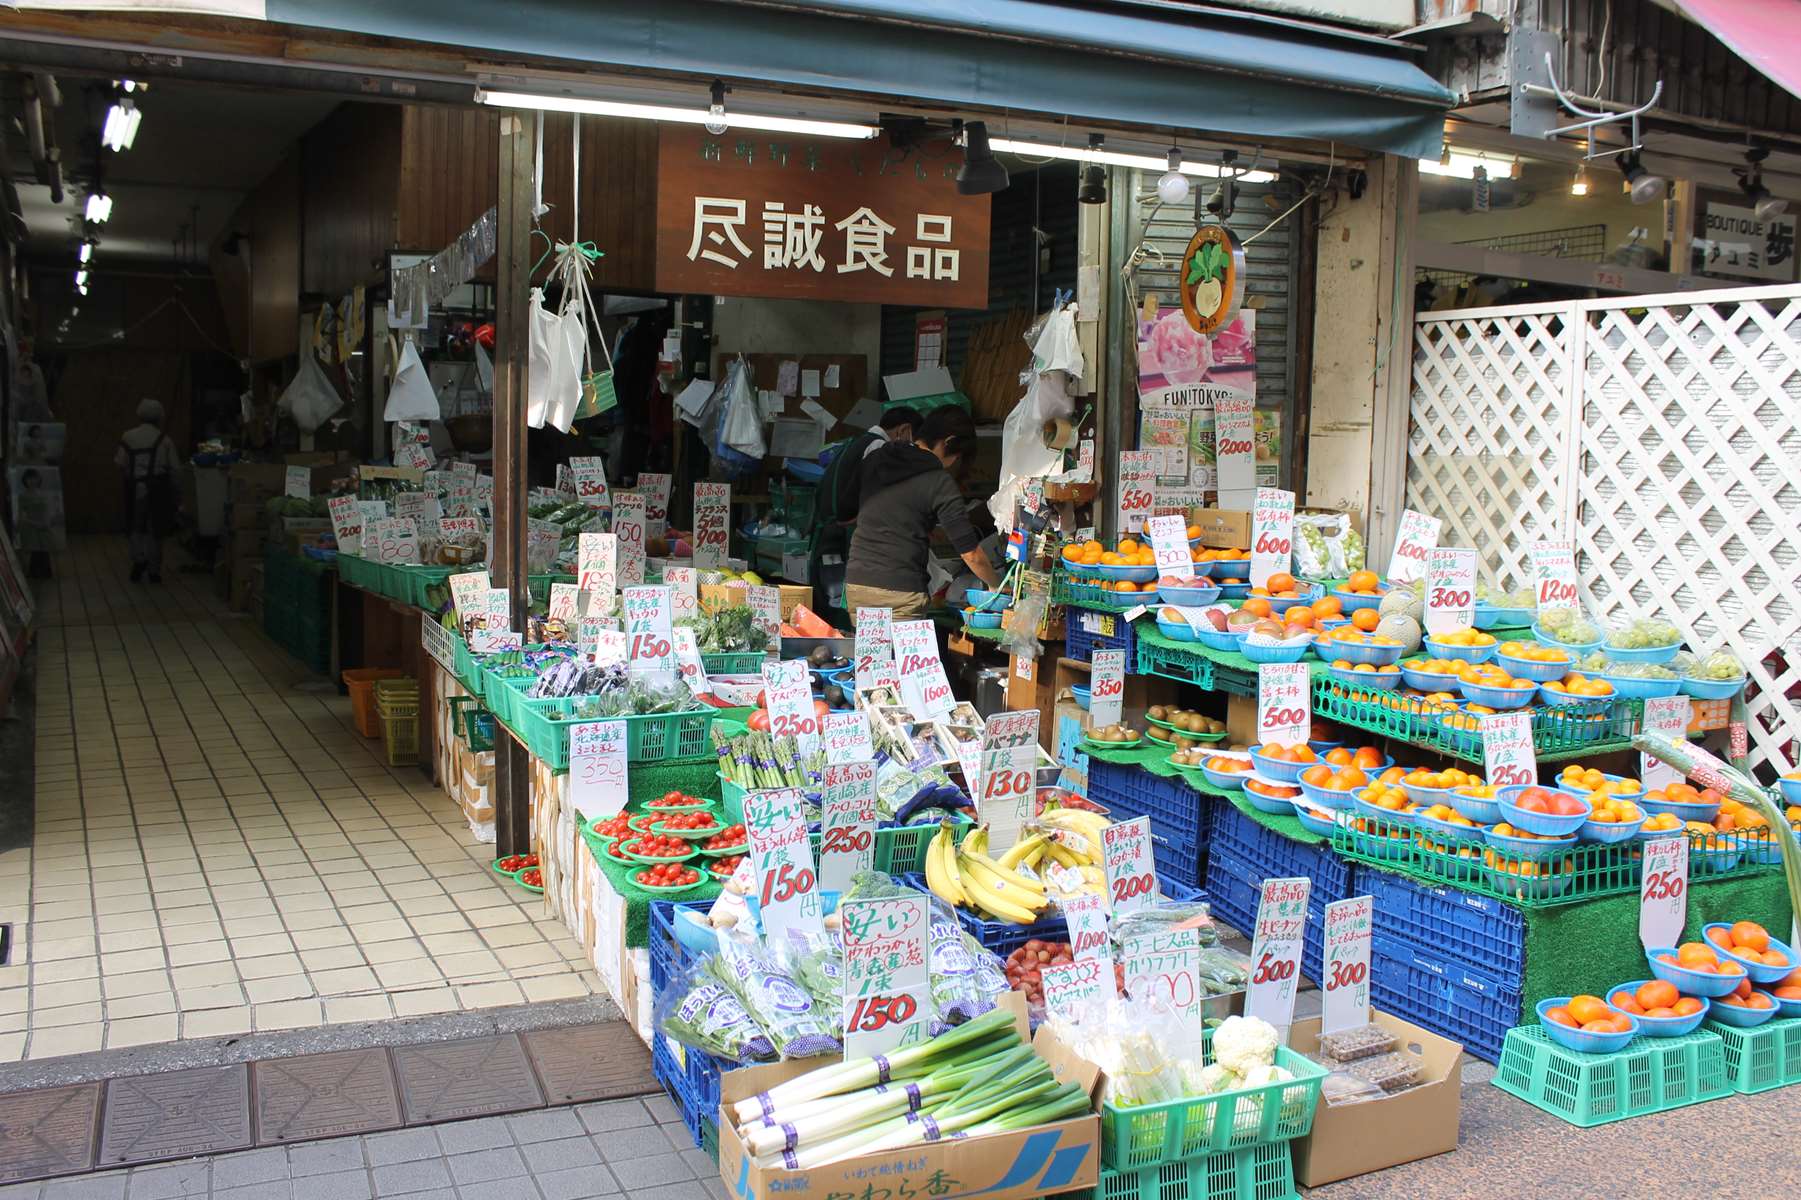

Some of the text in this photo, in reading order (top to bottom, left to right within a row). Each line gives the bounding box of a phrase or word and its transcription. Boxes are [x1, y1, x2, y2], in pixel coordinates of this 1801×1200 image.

[1706, 212, 1764, 237] BOUTIQUE
[686, 195, 960, 282] 尽誠食品
[1217, 438, 1253, 458] 2000
[578, 480, 606, 497] 350
[1121, 489, 1154, 512] 550
[644, 504, 666, 521] 50
[338, 524, 362, 540] 200
[613, 521, 643, 543] 150
[696, 530, 728, 549] 900
[1255, 531, 1292, 555] 600
[1429, 586, 1471, 608] 300
[1539, 578, 1578, 604] 1200
[630, 633, 672, 662] 150
[1092, 678, 1122, 698] 350
[773, 715, 817, 738] 250
[987, 716, 1037, 737] 健康果実
[1262, 705, 1307, 728] 500
[984, 731, 1033, 752] バナナ
[581, 757, 624, 780] 350
[986, 750, 1016, 772] 1袋
[826, 766, 873, 788] 最高品
[984, 769, 1032, 800] 130
[1491, 765, 1532, 784] 250
[825, 782, 874, 803] 長崎産
[748, 796, 802, 834] 安い
[1015, 794, 1030, 819] 円
[821, 826, 873, 856] 250
[1104, 822, 1144, 845] 自家製
[760, 846, 795, 872] 1袋
[855, 850, 871, 872] 円
[760, 864, 815, 909] 150
[1112, 873, 1154, 906] 200
[1264, 882, 1306, 904] 最高品
[1643, 870, 1684, 903] 250
[800, 892, 819, 919] 円
[847, 900, 911, 944] 安い
[1125, 931, 1196, 955] サービス品
[1252, 952, 1296, 985] 500
[1327, 959, 1367, 992] 300
[857, 971, 893, 996] 1束
[846, 993, 917, 1033] 150
[898, 1022, 921, 1047] 円
